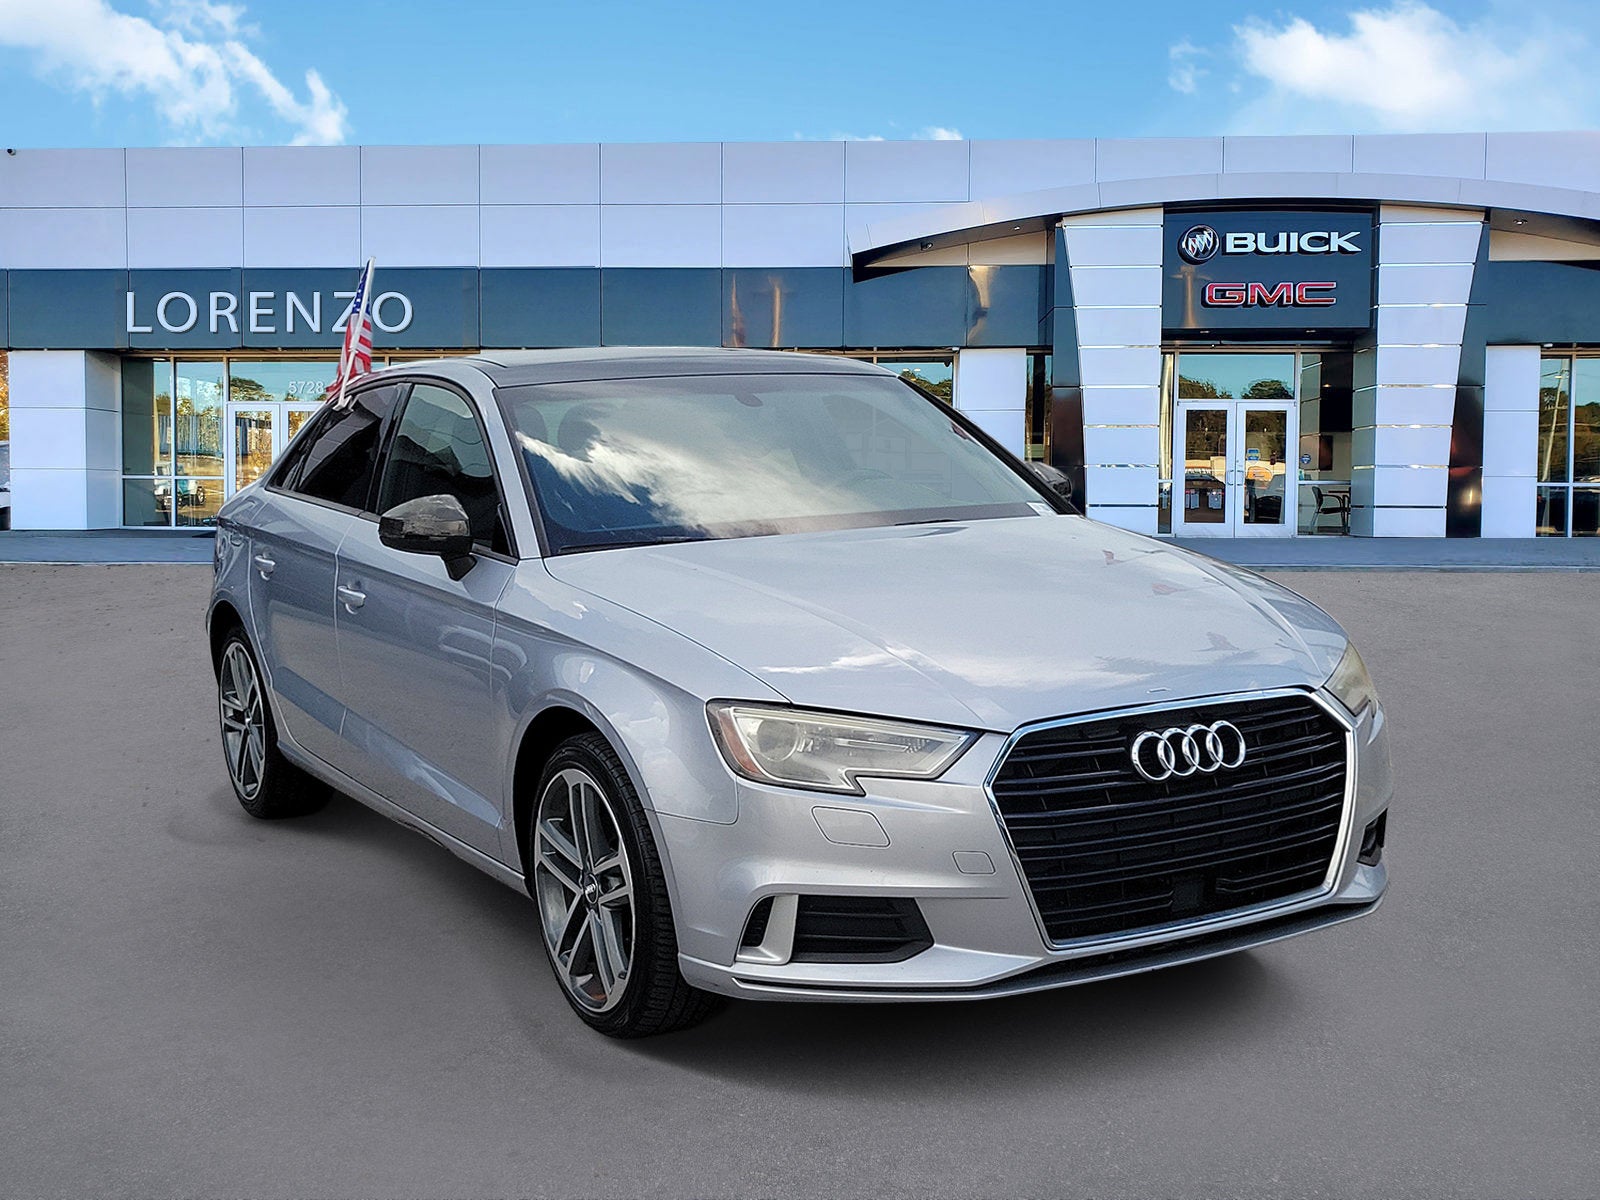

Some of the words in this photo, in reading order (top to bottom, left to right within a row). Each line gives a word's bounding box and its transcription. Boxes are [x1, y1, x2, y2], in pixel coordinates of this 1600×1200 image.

[1225, 231, 1362, 253] BUICK
[1204, 281, 1337, 306] GMC
[125, 291, 413, 333] LORENZO
[288, 381, 325, 394] 5728
